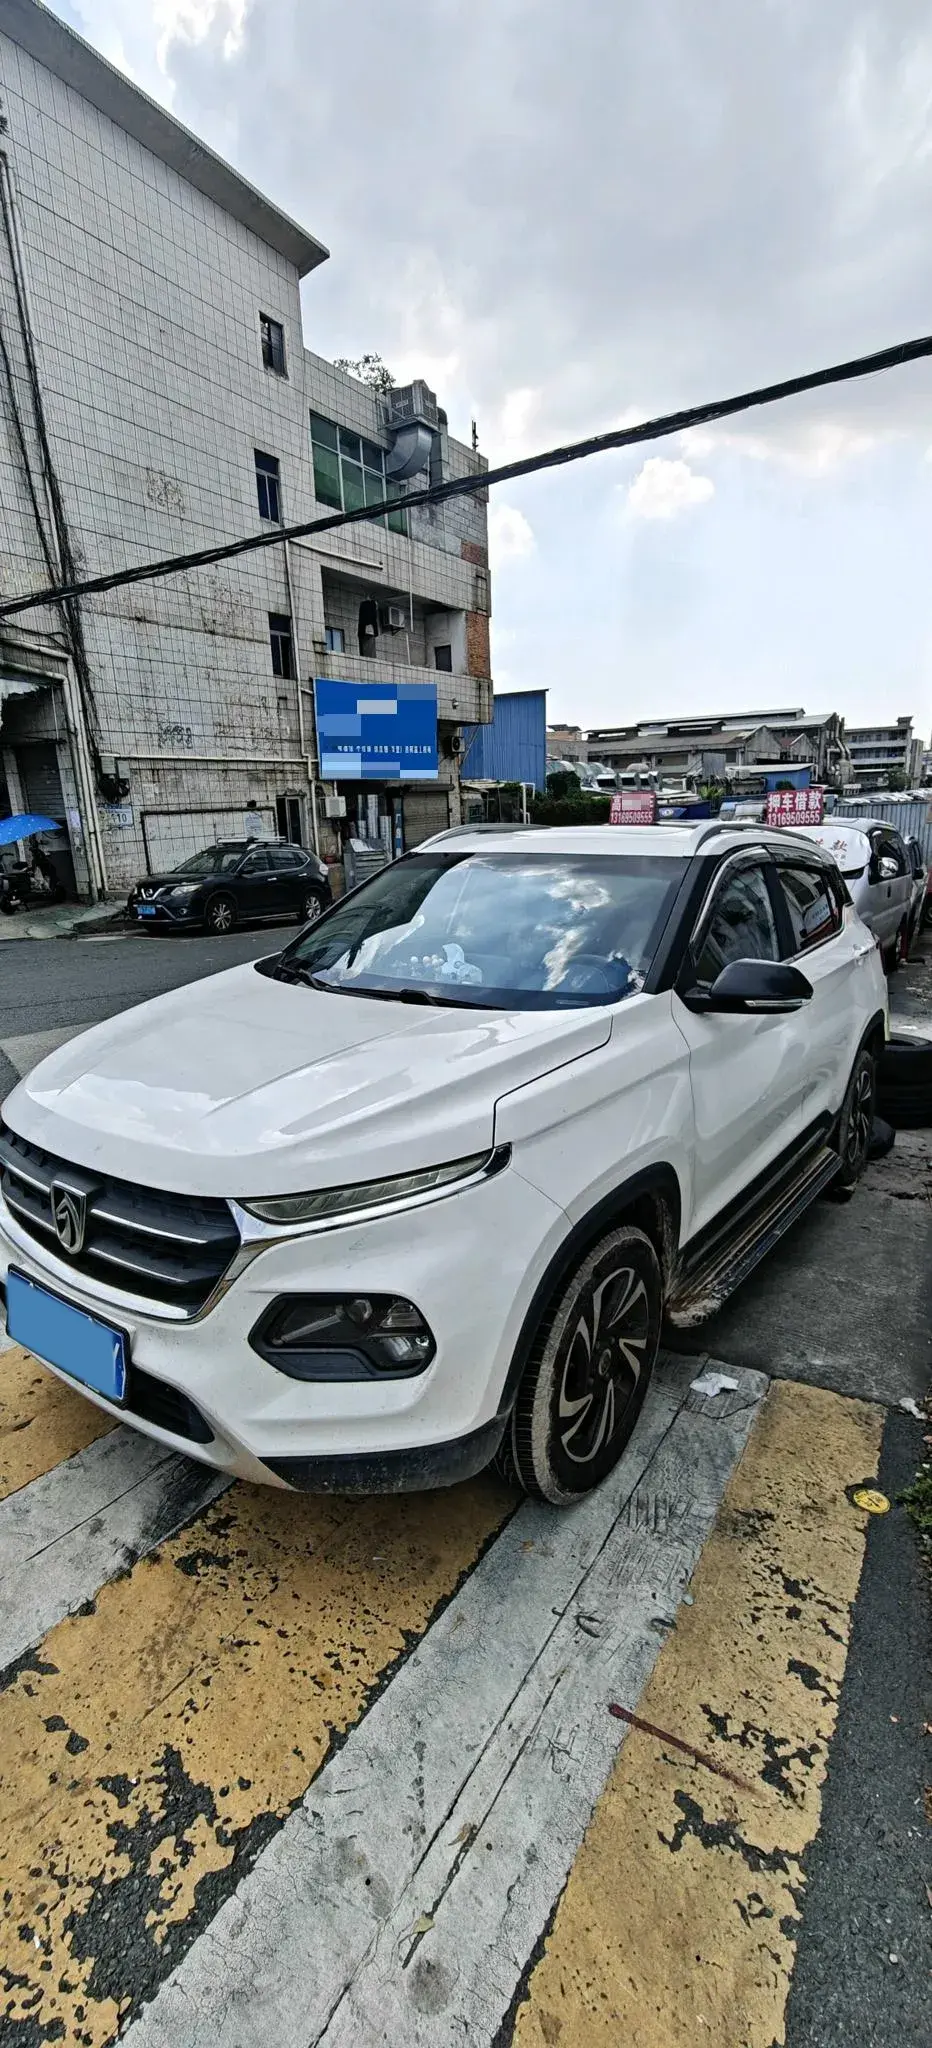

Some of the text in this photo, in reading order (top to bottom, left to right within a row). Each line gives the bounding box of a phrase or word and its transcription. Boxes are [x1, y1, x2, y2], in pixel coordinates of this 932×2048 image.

[768, 790, 821, 812] 押车借款
[610, 811, 653, 824] 13169509555
[767, 810, 820, 826] 13169509555
